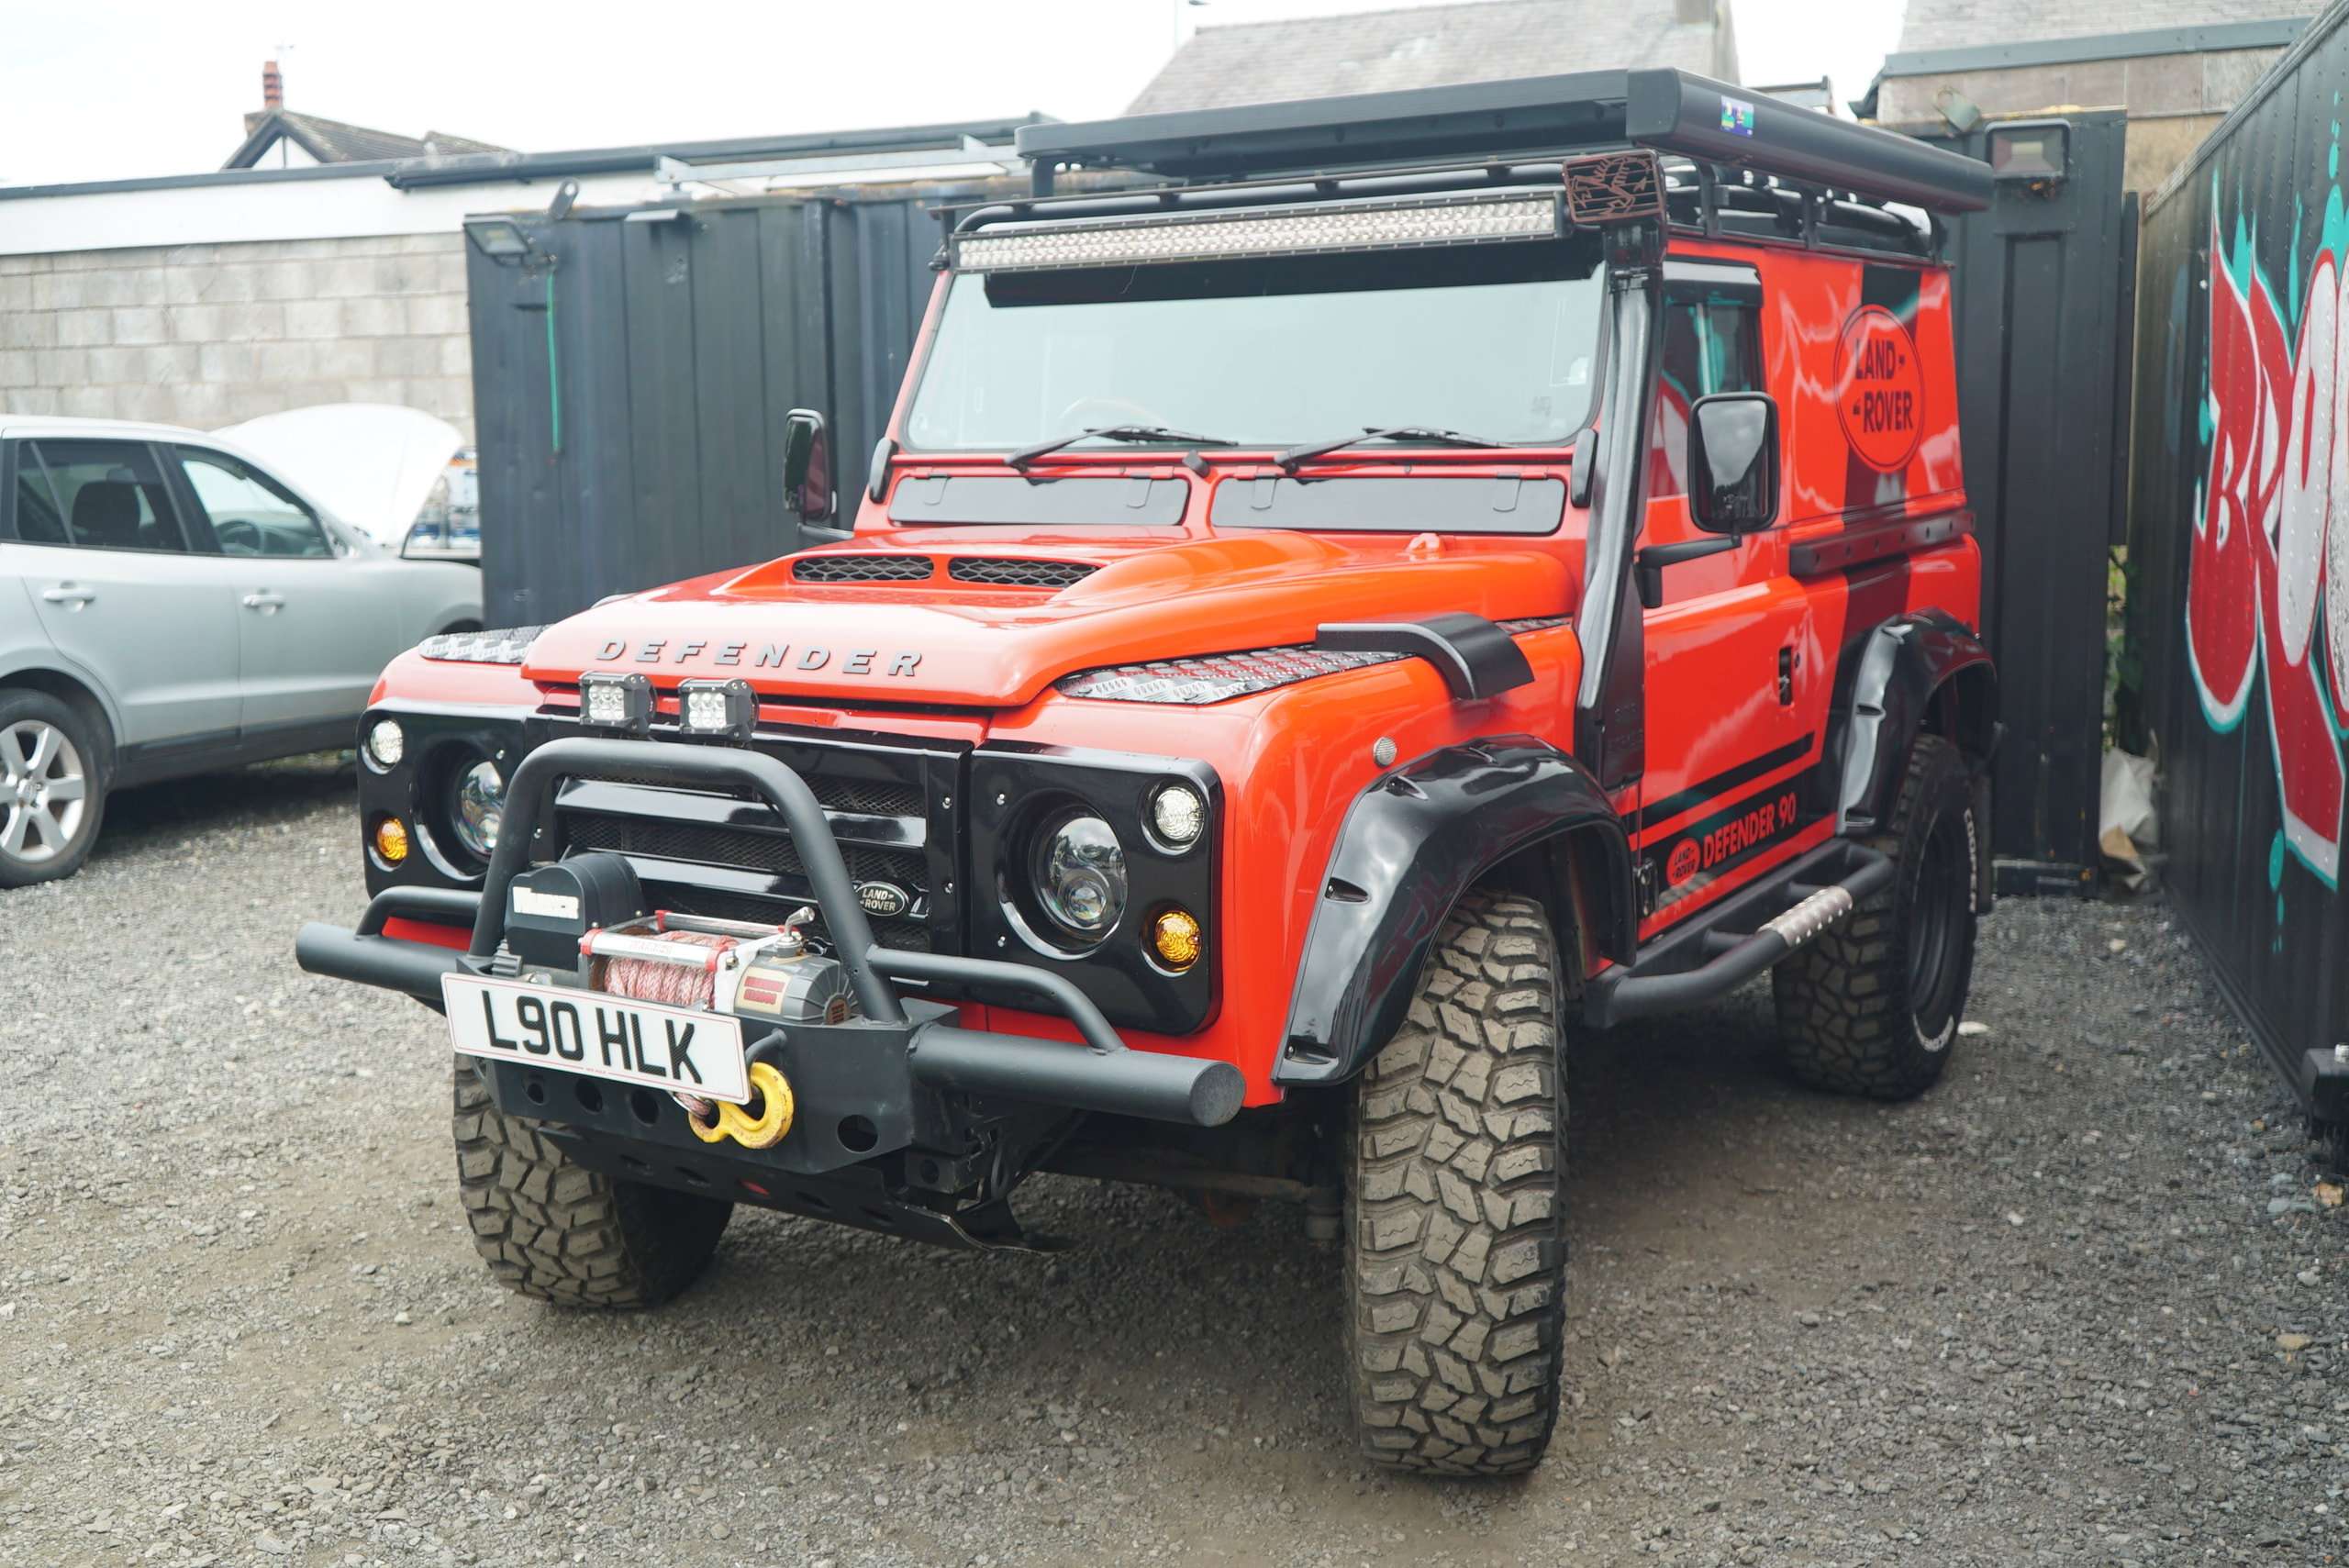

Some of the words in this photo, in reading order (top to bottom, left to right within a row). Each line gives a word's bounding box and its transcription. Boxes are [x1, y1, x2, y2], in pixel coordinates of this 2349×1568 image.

[595, 639, 923, 676] DEFENDER
[1703, 803, 1776, 869] DEFENDER
[1778, 792, 1797, 828] 90
[480, 990, 584, 1062] L90
[595, 1006, 703, 1084] HLK
